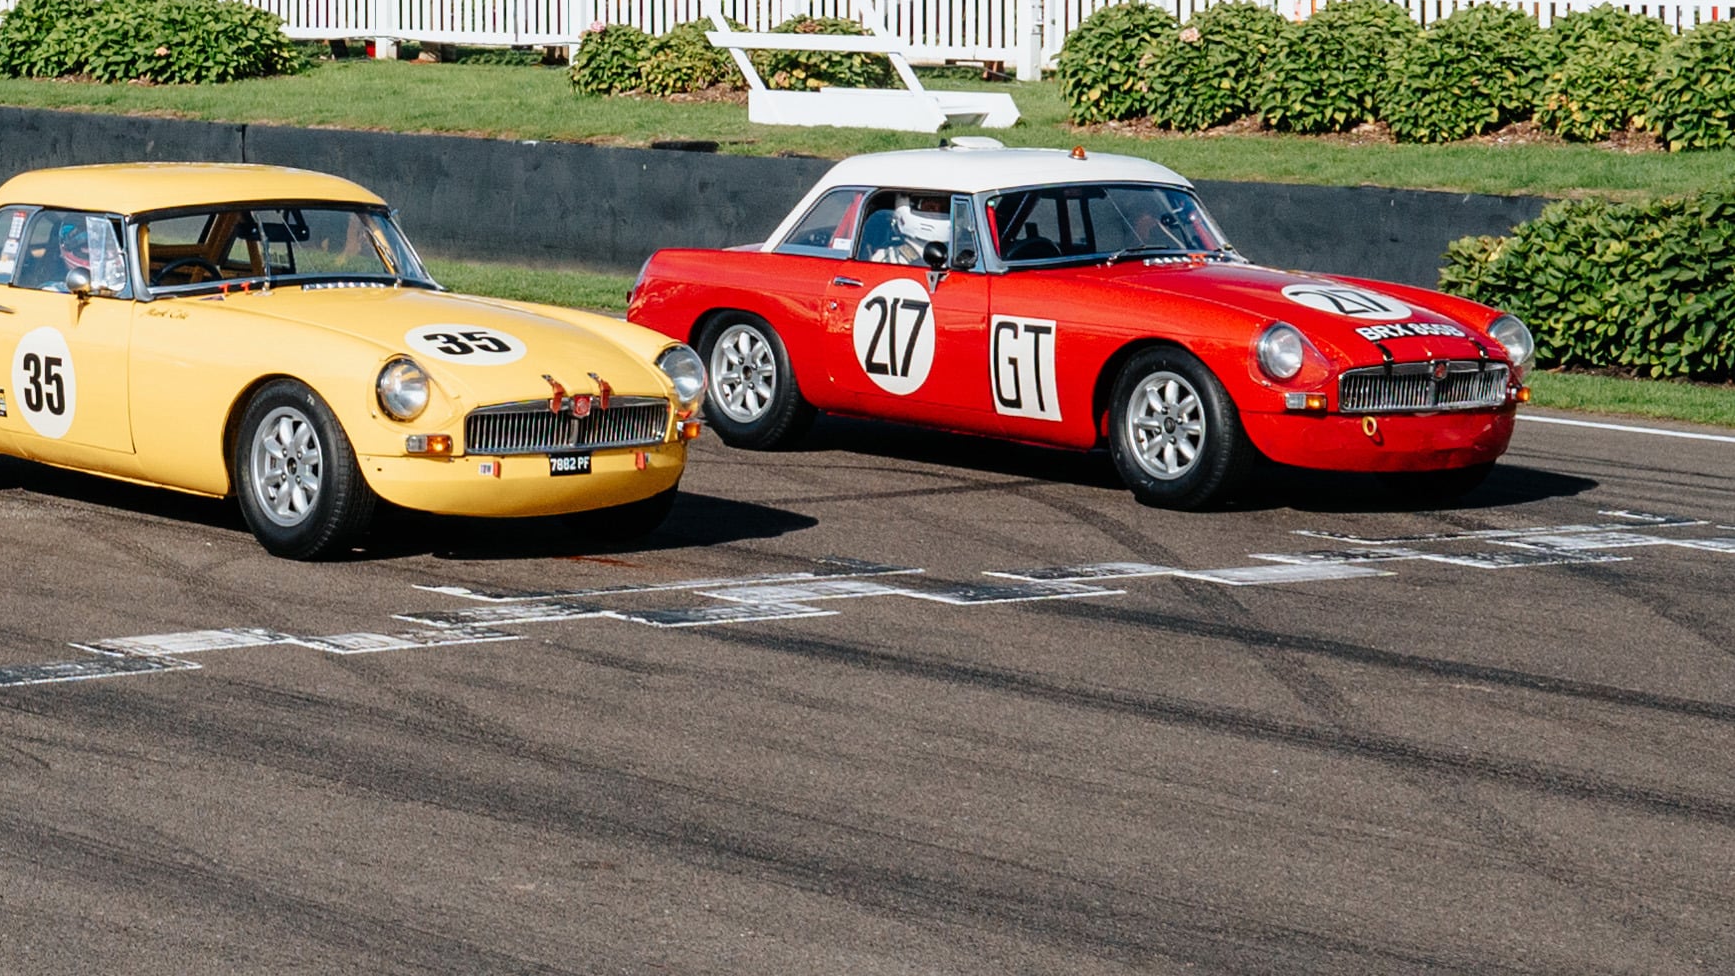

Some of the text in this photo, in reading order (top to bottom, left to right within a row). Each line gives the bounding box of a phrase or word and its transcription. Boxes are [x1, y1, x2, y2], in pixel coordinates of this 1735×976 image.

[423, 331, 512, 356] 35
[865, 295, 931, 378] 217
[1355, 323, 1415, 341] BRX
[23, 352, 66, 416] 35
[993, 321, 1053, 413] GT
[577, 456, 590, 470] PF
